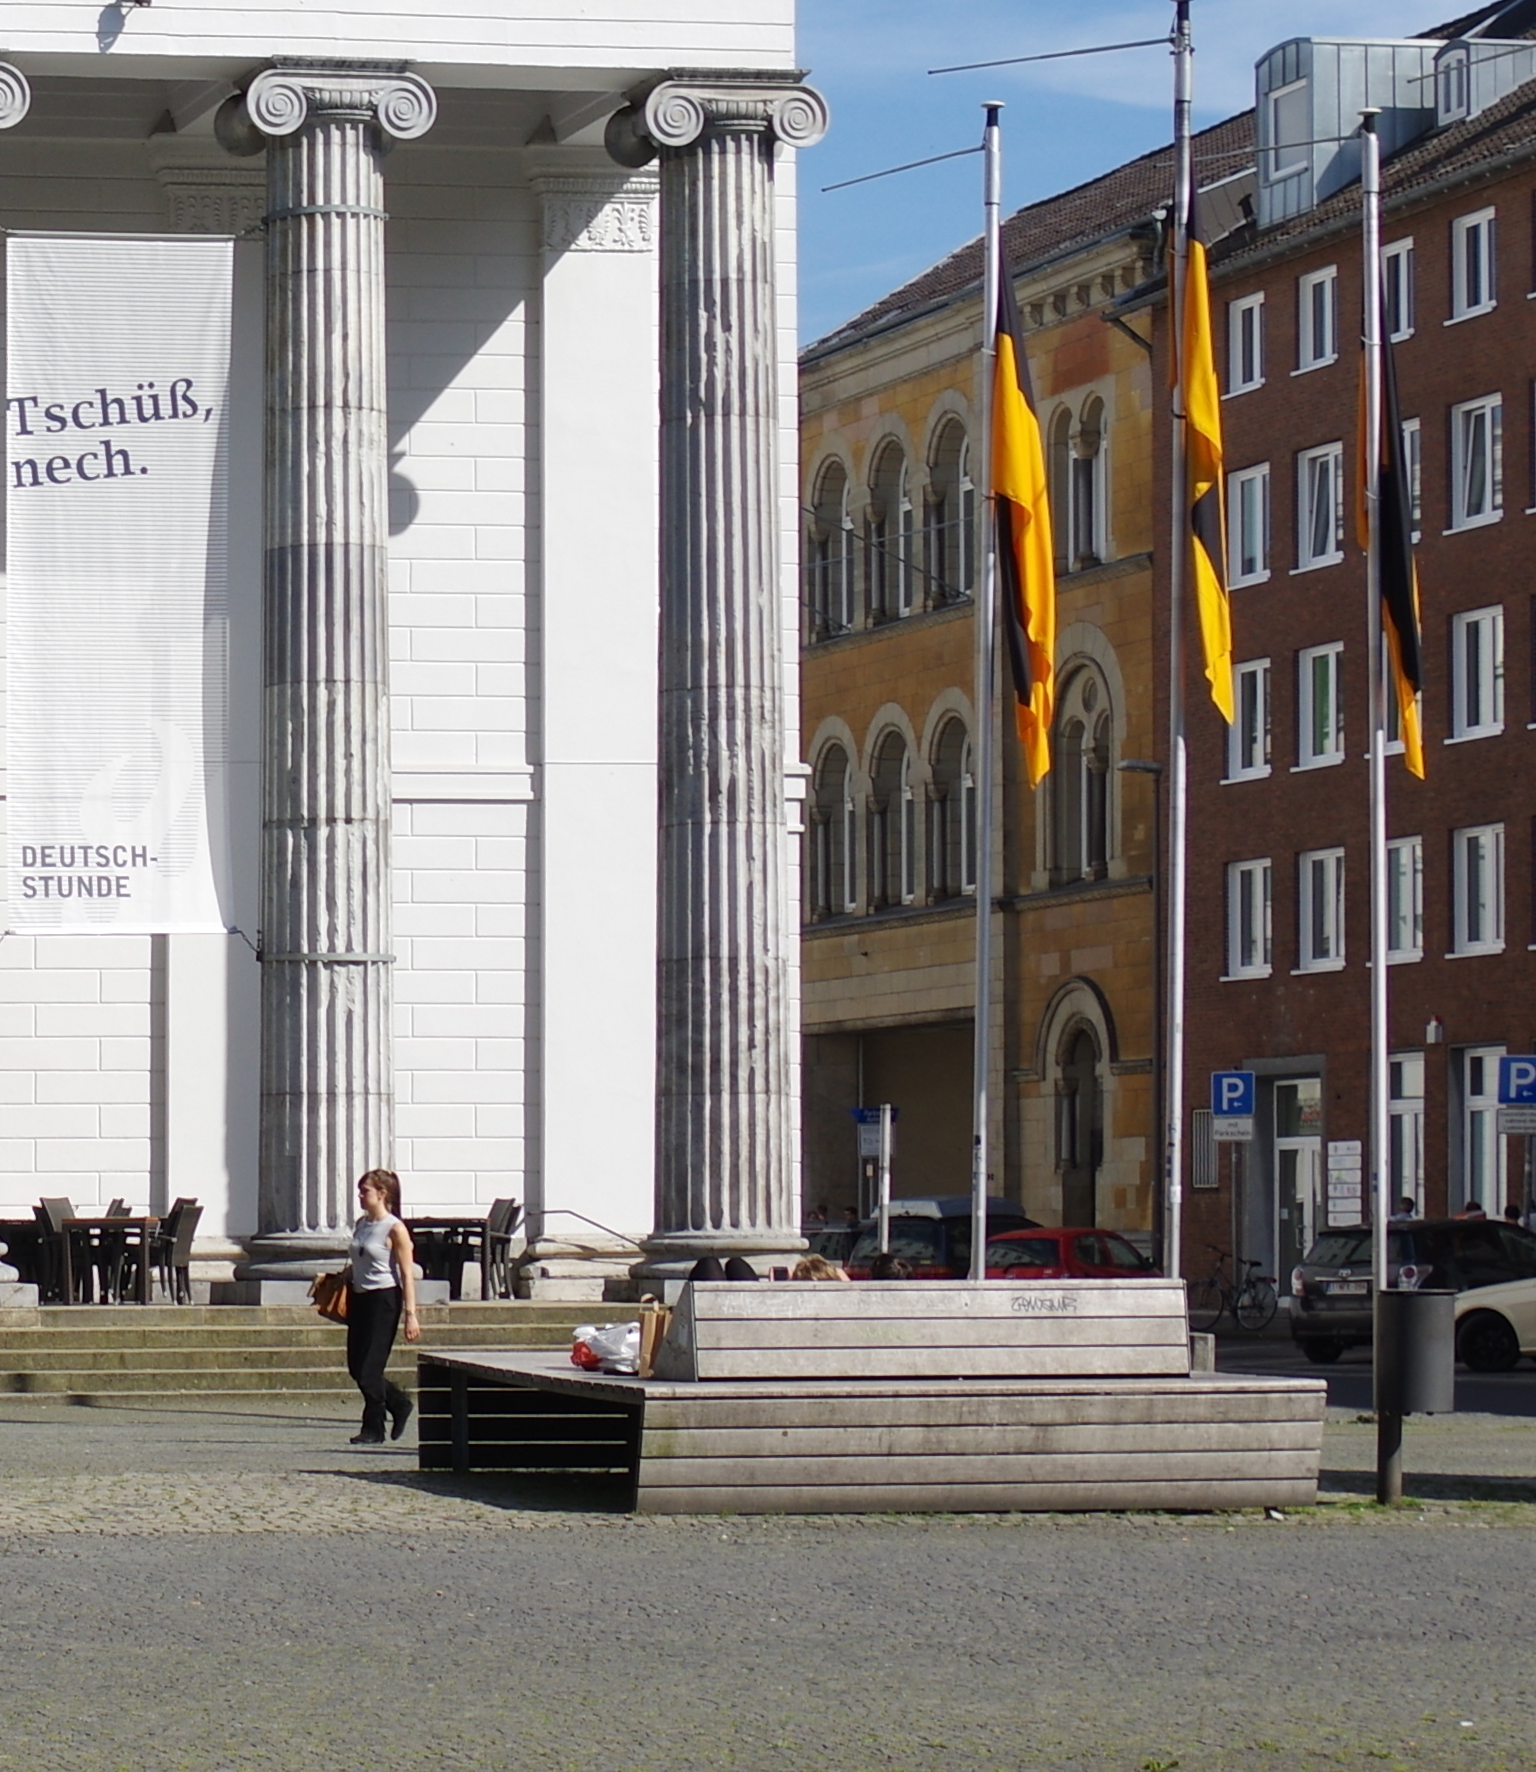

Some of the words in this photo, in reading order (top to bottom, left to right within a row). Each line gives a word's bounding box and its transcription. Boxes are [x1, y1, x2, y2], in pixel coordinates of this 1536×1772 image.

[6, 378, 213, 436] Tschüß,
[10, 439, 148, 489] nech.
[22, 845, 158, 868] DEUTSCH-
[22, 876, 131, 898] STUNDE
[1222, 1077, 1244, 1110] P
[1509, 1062, 1536, 1098] P
